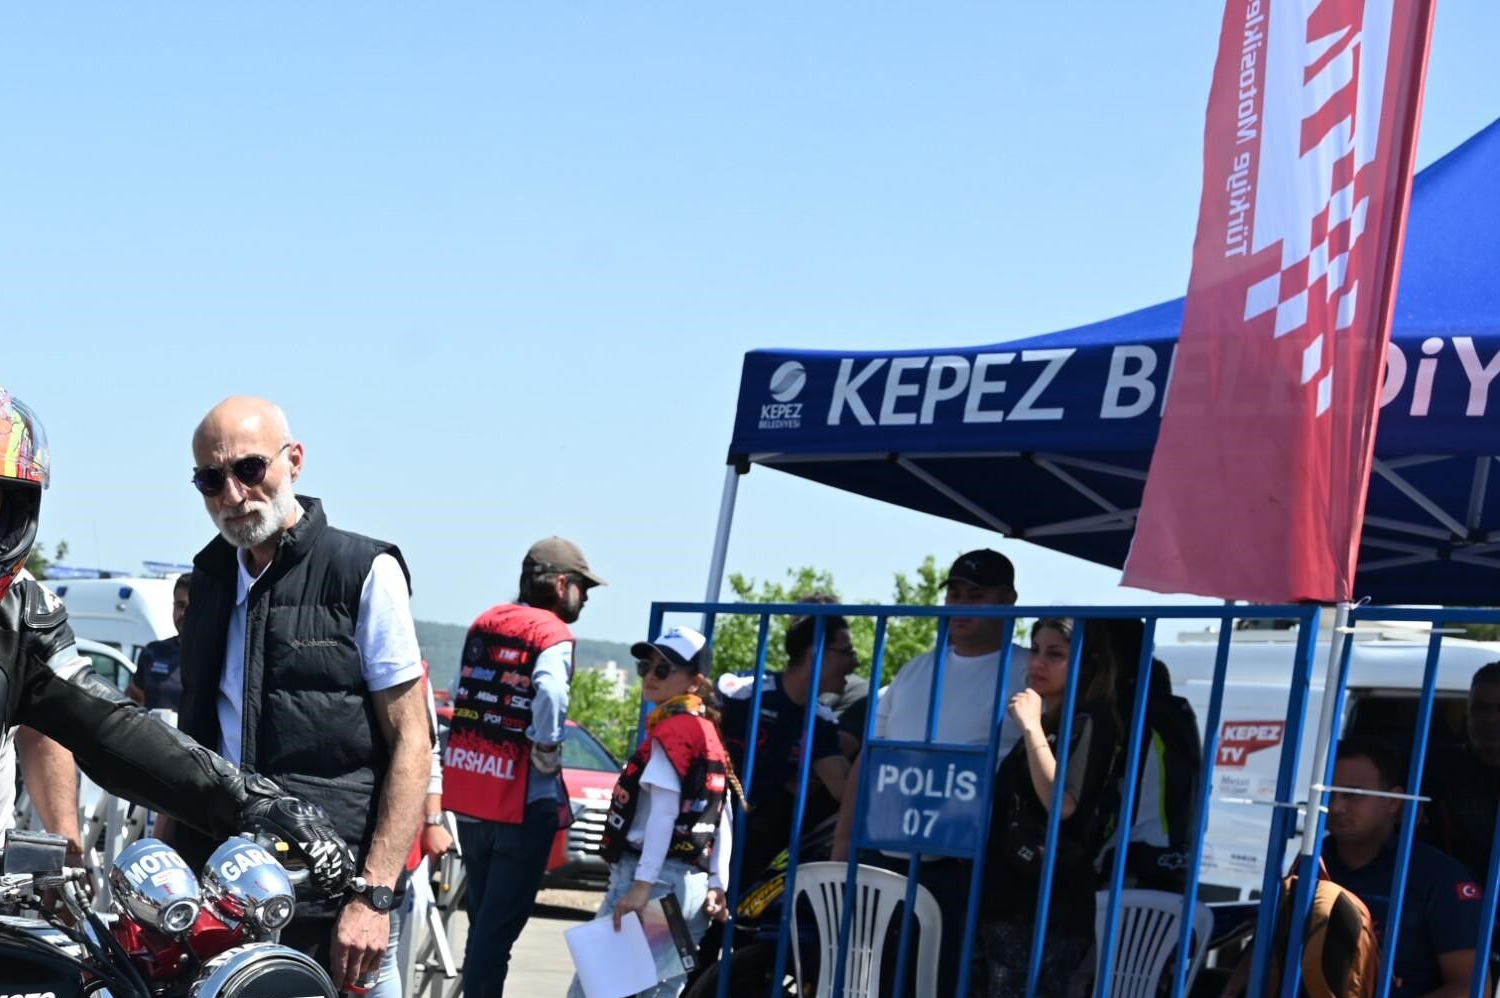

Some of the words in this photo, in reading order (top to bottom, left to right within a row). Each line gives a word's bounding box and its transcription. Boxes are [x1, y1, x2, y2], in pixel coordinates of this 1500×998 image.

[826, 347, 1077, 427] KEPEZ
[760, 403, 803, 420] KEPEZ
[1222, 724, 1281, 741] KEPEZ
[443, 746, 516, 780] ARSHALL
[1220, 746, 1245, 763] TV
[877, 763, 978, 801] POLİS
[902, 807, 941, 839] 07
[125, 850, 189, 887] MOTO
